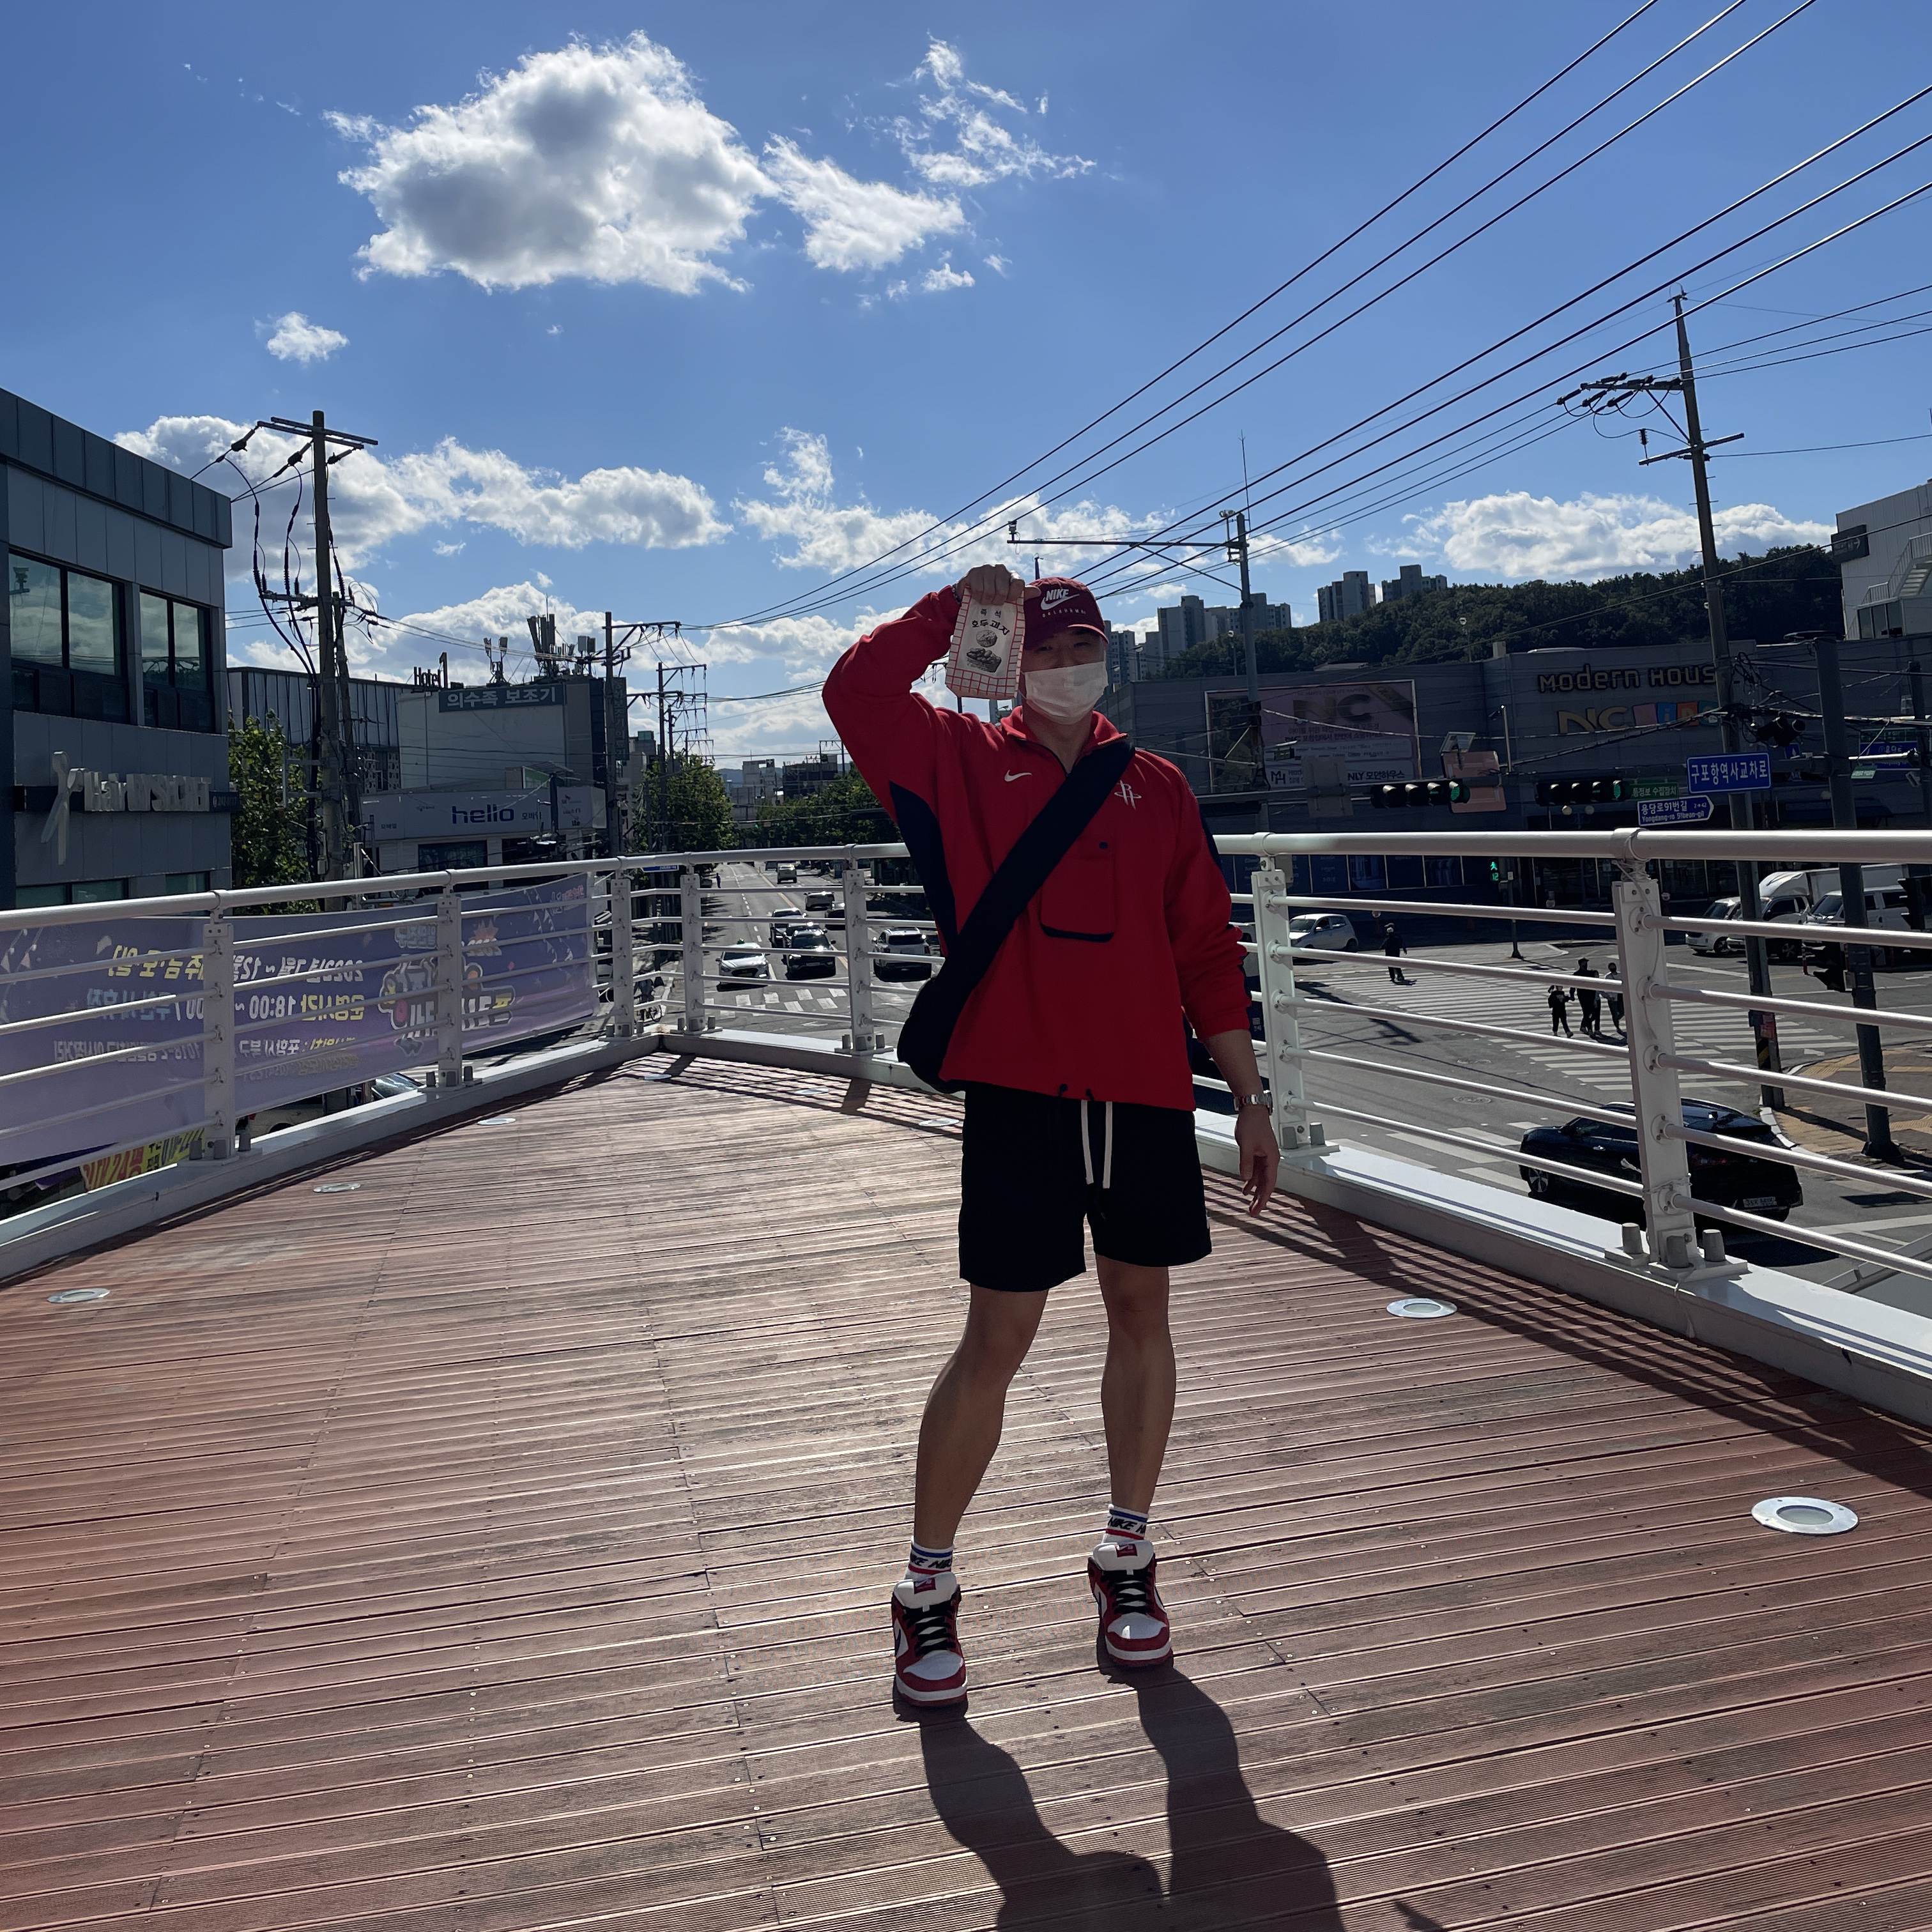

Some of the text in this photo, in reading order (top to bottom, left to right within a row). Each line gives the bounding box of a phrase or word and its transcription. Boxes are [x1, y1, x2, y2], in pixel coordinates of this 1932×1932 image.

[1045, 588, 1070, 601] NIKE
[414, 666, 441, 689] Hotel
[447, 687, 556, 709] 의수족 보조기
[1293, 694, 1372, 722] NC
[1557, 706, 1629, 733] NC
[1347, 770, 1406, 781] NLY 모던하우스
[1691, 760, 1768, 785] 구포항역사교차로
[1633, 787, 1652, 797] 통정보
[452, 804, 514, 824] hello
[1641, 801, 1687, 815] 용당로91번길
[1107, 1516, 1137, 1530] NIKE
